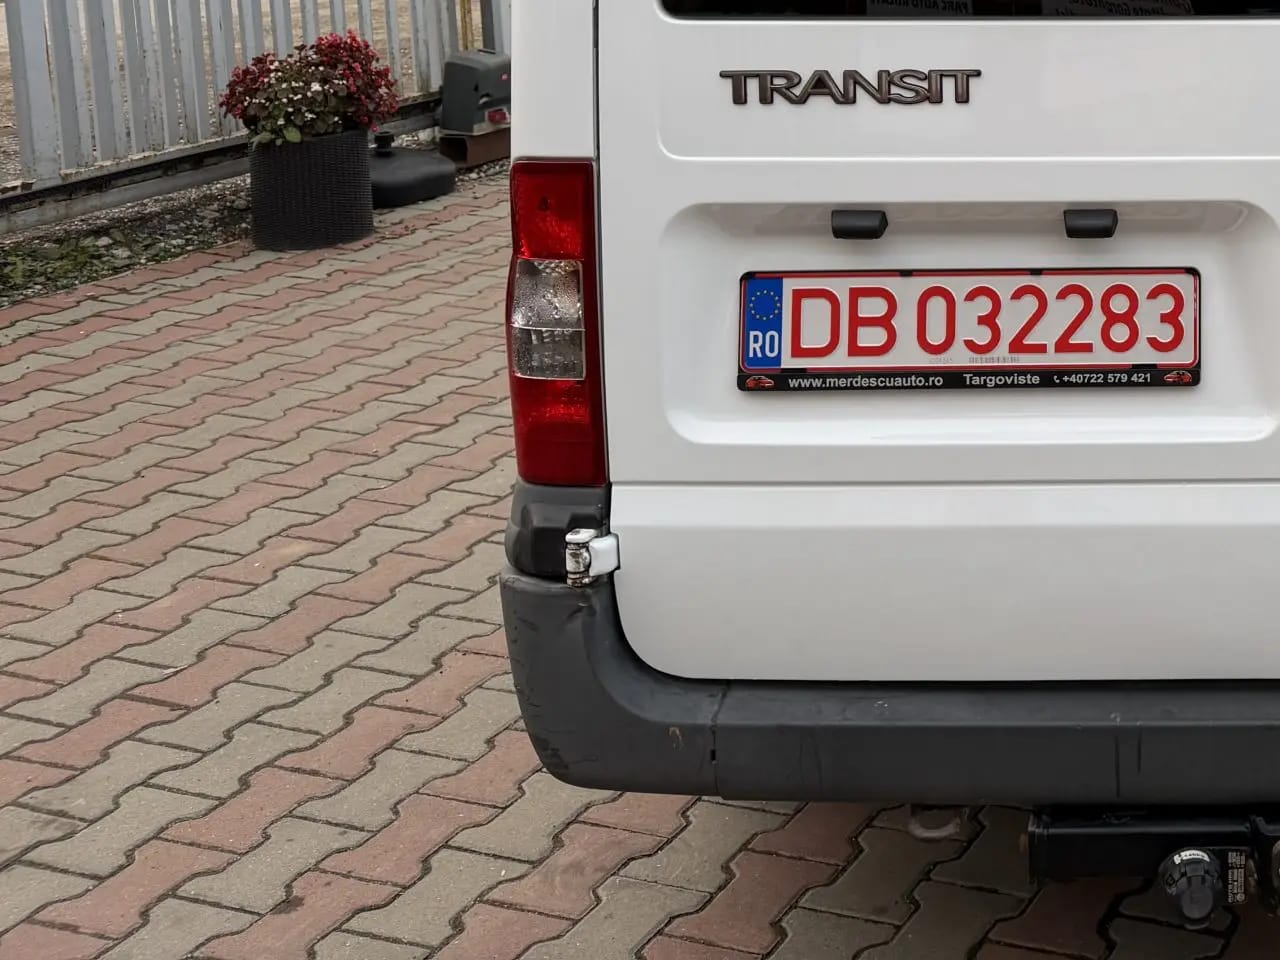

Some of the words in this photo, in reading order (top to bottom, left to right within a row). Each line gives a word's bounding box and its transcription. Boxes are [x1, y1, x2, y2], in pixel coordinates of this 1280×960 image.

[719, 69, 982, 105] TRANSIT
[791, 286, 898, 358] DB
[916, 283, 1185, 355] 032283
[748, 331, 779, 358] RO
[788, 374, 944, 388] www.merdescuauto.ro
[963, 373, 1041, 387] Targoviste
[1062, 373, 1104, 383] +40722
[1107, 373, 1128, 383] 579
[1131, 373, 1151, 382] 421
